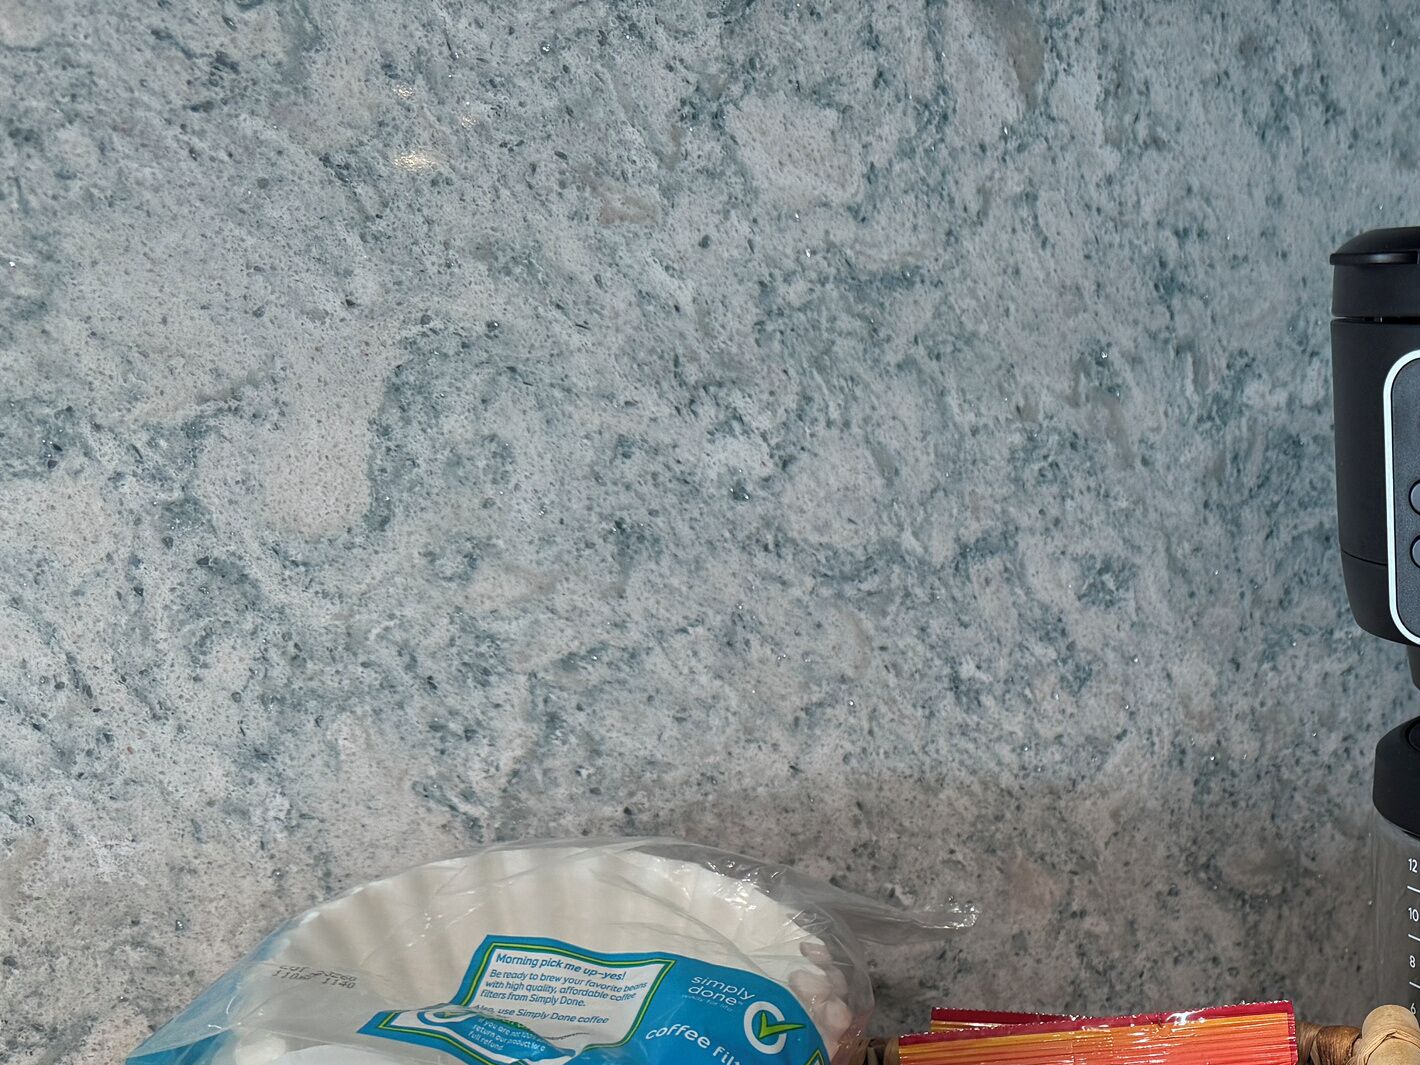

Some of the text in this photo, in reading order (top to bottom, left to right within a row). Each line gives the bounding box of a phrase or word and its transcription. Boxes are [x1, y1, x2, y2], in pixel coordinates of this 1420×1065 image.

[1408, 858, 1418, 874] 12
[1408, 907, 1420, 922] 10
[495, 953, 540, 969] Morning
[538, 955, 564, 970] pick
[564, 963, 582, 973] me
[1409, 955, 1416, 968] 8
[485, 980, 637, 1002] with high quality, affordable coffee
[489, 969, 649, 994] Be ready to brew your favorite beans
[691, 975, 756, 1000] simply
[480, 989, 506, 1001] filters
[506, 990, 529, 1003] from
[528, 993, 559, 1006] Simply
[687, 986, 738, 1006] done
[497, 1007, 516, 1016] use
[516, 1008, 550, 1020] Simply
[550, 1012, 576, 1023] Done
[577, 1014, 610, 1025] coffee
[1410, 1002, 1417, 1015] 6
[645, 1023, 711, 1049] coffee
